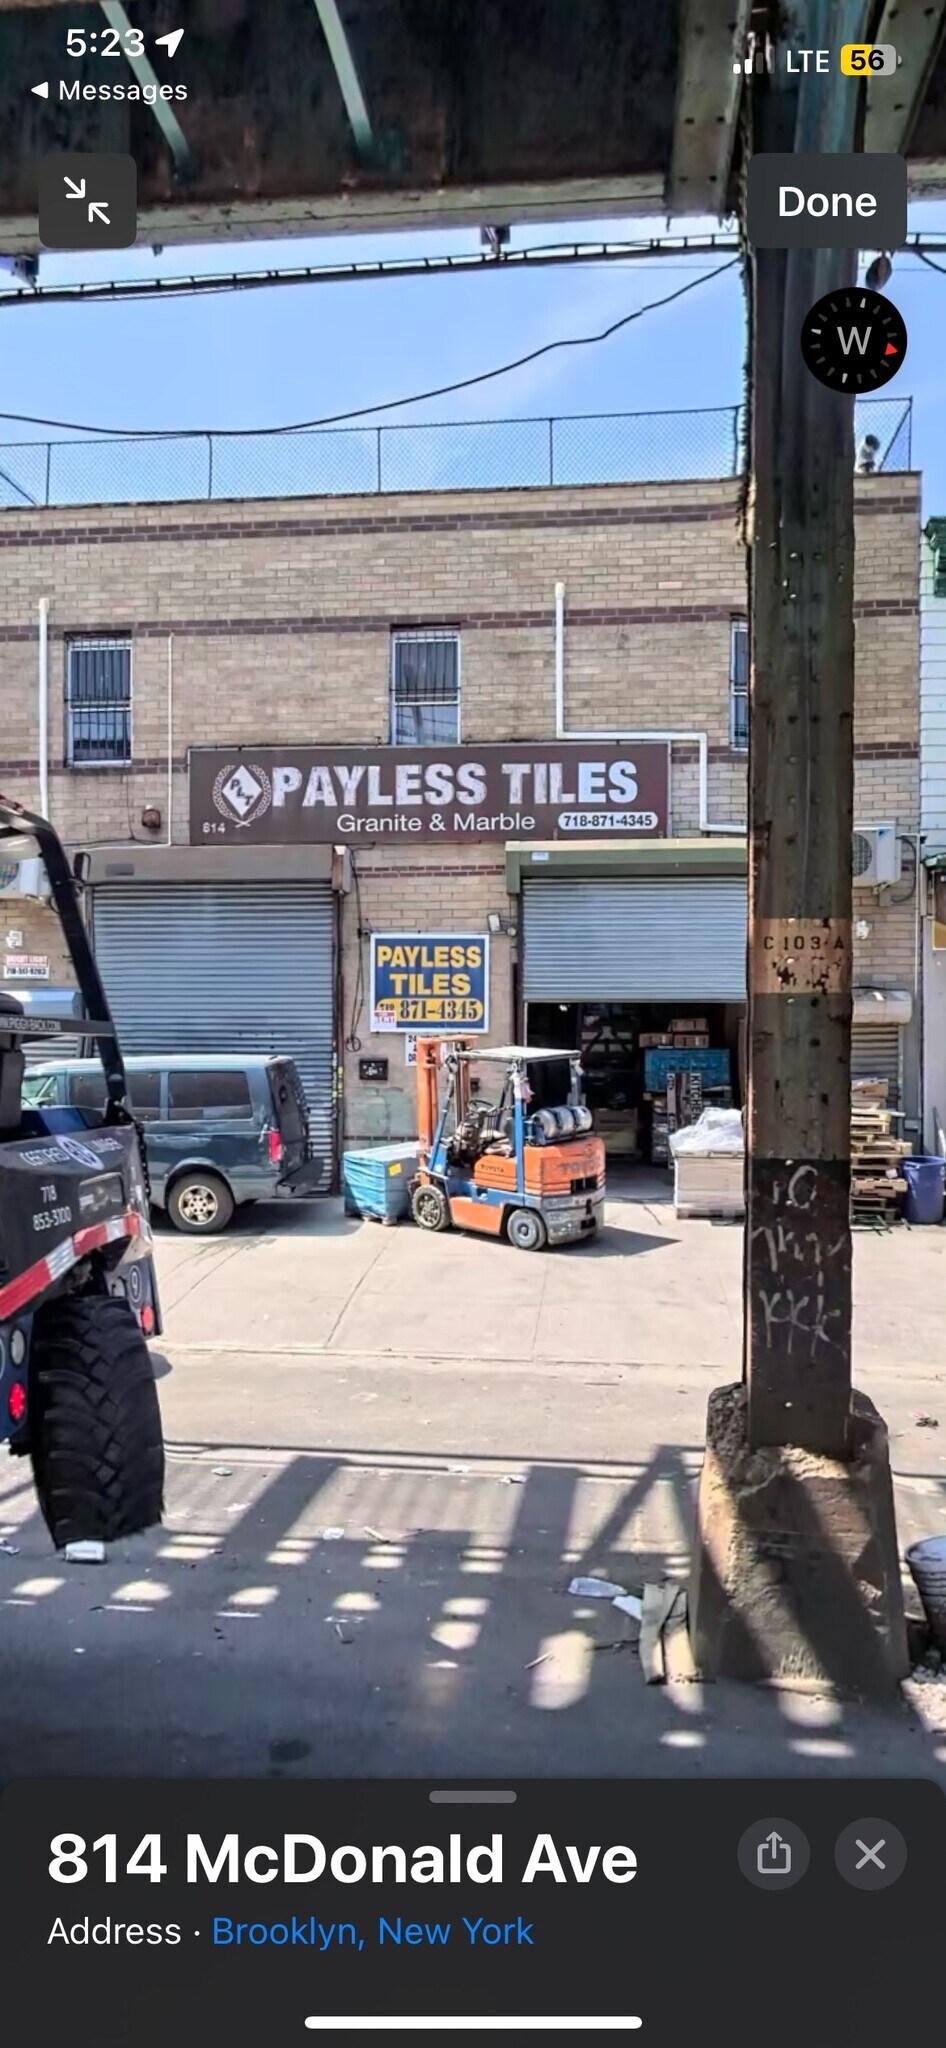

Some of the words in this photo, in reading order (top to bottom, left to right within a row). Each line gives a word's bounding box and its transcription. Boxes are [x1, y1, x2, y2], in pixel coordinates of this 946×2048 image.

[271, 763, 487, 807] PAYLESS
[502, 760, 638, 804] TILES
[202, 822, 226, 833] 814
[336, 813, 422, 832] Granite
[429, 813, 446, 832] &
[453, 812, 536, 831] Marble
[563, 814, 653, 827] 718-871-4345
[377, 945, 482, 968] PAYLESS
[389, 973, 471, 996] TILES
[400, 999, 478, 1020] 871-4345
[40, 1185, 58, 1203] 718
[32, 1206, 72, 1231] 853-3100
